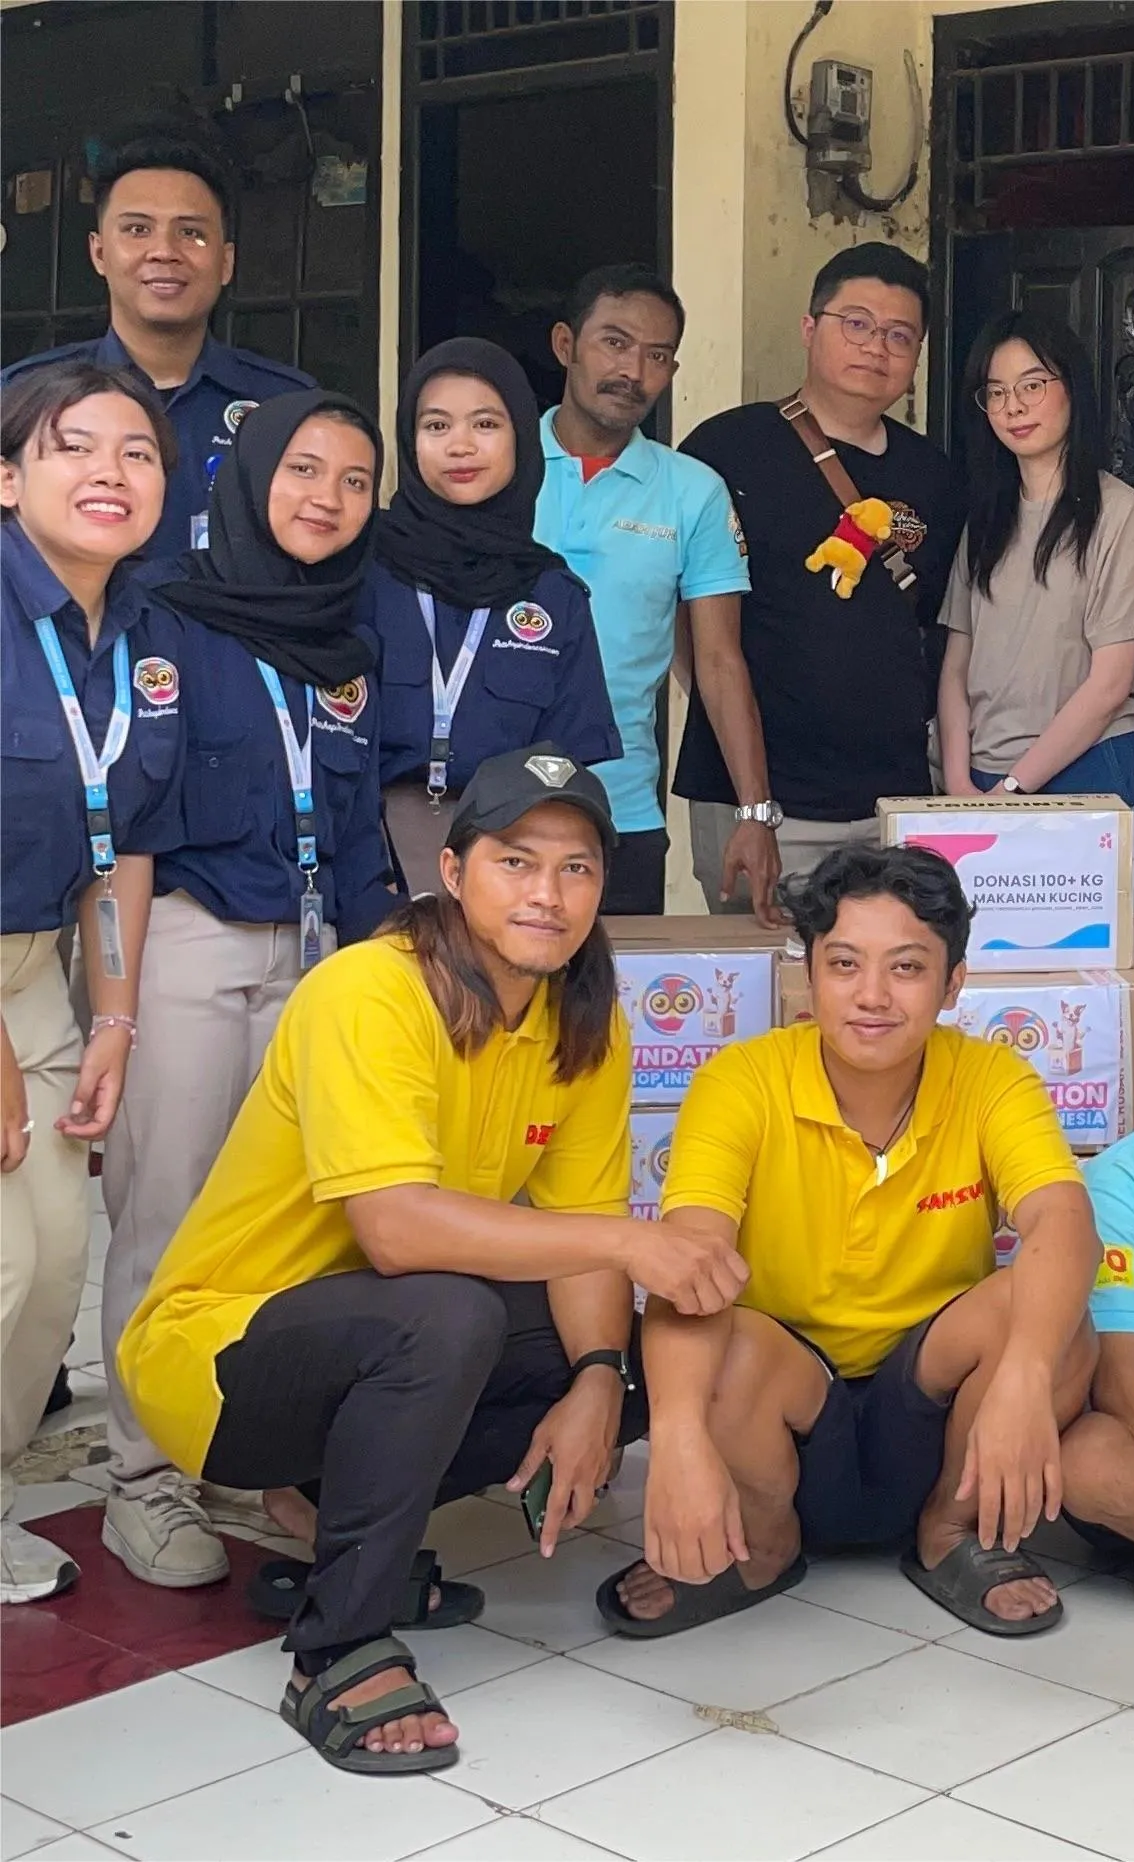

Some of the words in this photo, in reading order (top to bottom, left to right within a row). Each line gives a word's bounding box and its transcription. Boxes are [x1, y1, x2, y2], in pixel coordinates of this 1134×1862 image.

[974, 874, 1036, 888] DONASI
[1040, 874, 1076, 887] 100+
[1081, 874, 1104, 887] KG
[973, 892, 1045, 904] MAKANAN
[1049, 891, 1103, 904] KUCING
